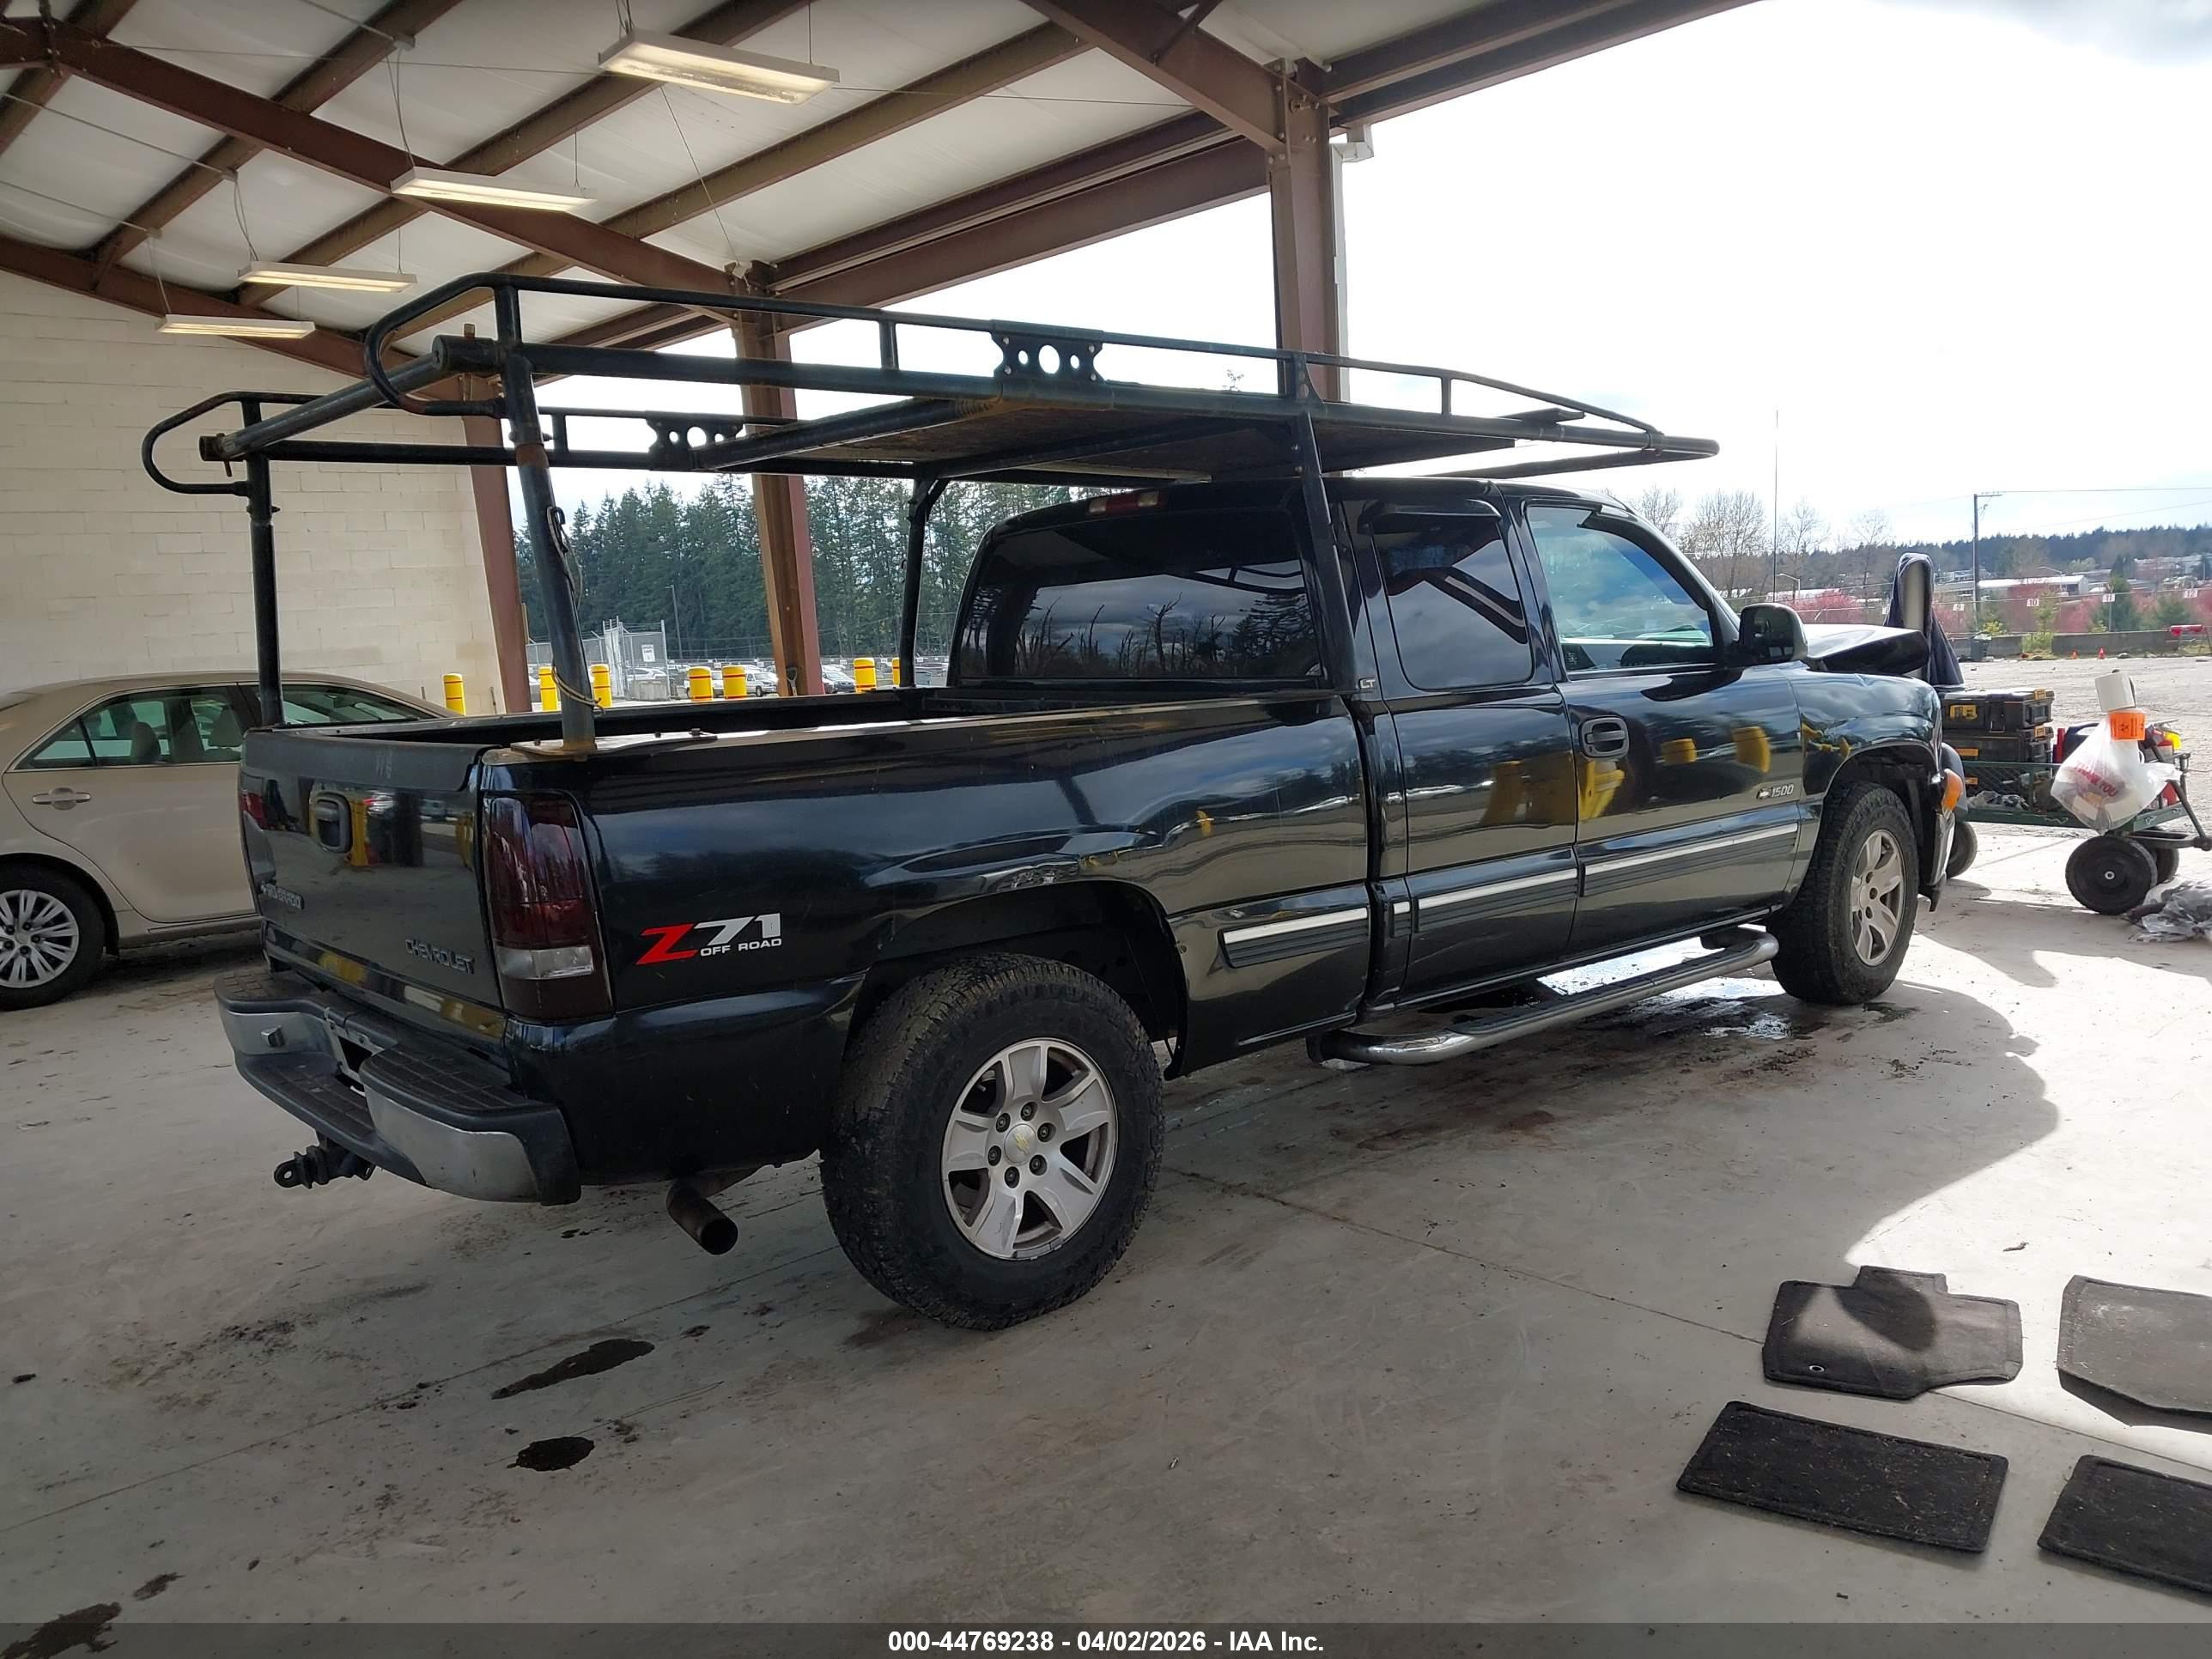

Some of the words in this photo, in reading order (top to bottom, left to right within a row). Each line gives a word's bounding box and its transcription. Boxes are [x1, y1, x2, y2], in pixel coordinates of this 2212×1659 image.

[1360, 679, 1376, 689] LT
[1771, 784, 1794, 798] 1500
[635, 913, 781, 965] Z71
[700, 945, 731, 957] OFF
[738, 938, 781, 951] ROAD
[405, 939, 473, 975] CHEVROLET
